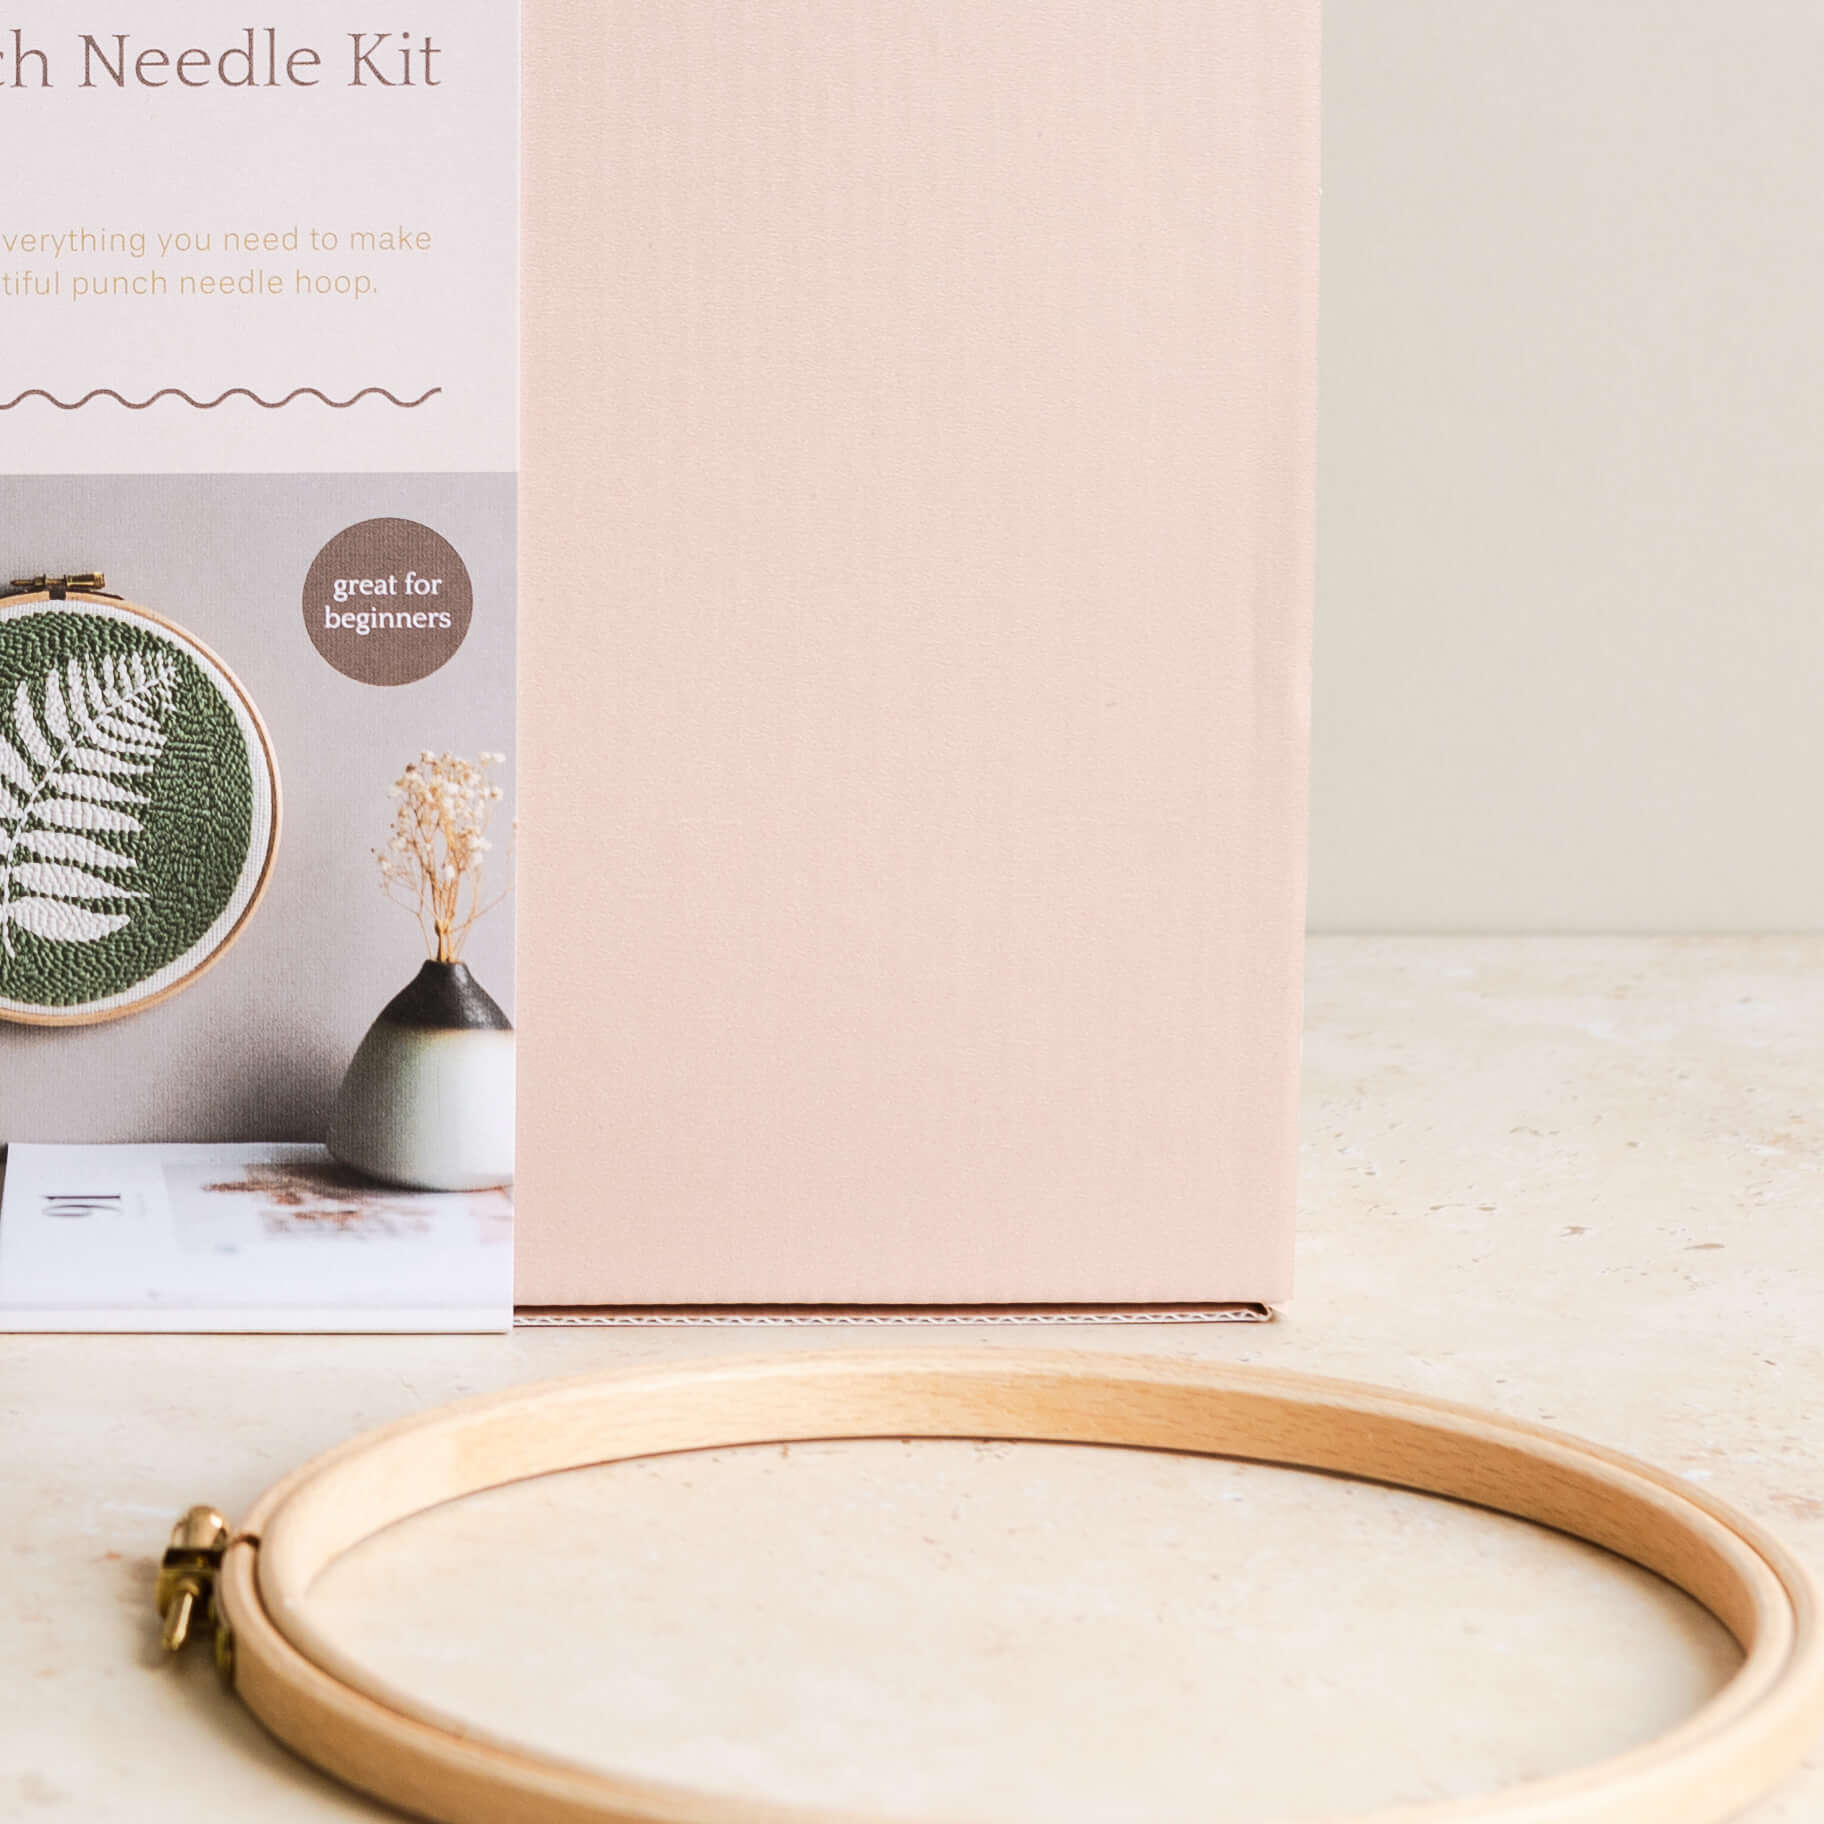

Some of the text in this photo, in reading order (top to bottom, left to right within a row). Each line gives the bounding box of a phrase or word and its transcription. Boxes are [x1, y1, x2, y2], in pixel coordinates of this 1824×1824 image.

[78, 27, 321, 88] Needle
[347, 32, 442, 87] Kit
[157, 232, 211, 257] you
[224, 226, 298, 251] need
[310, 228, 338, 251] to
[351, 226, 432, 251] make
[73, 269, 167, 302] punch
[179, 268, 284, 295] needle
[296, 268, 378, 300] hoop.
[333, 571, 442, 602] great for
[324, 605, 452, 636] beginners
